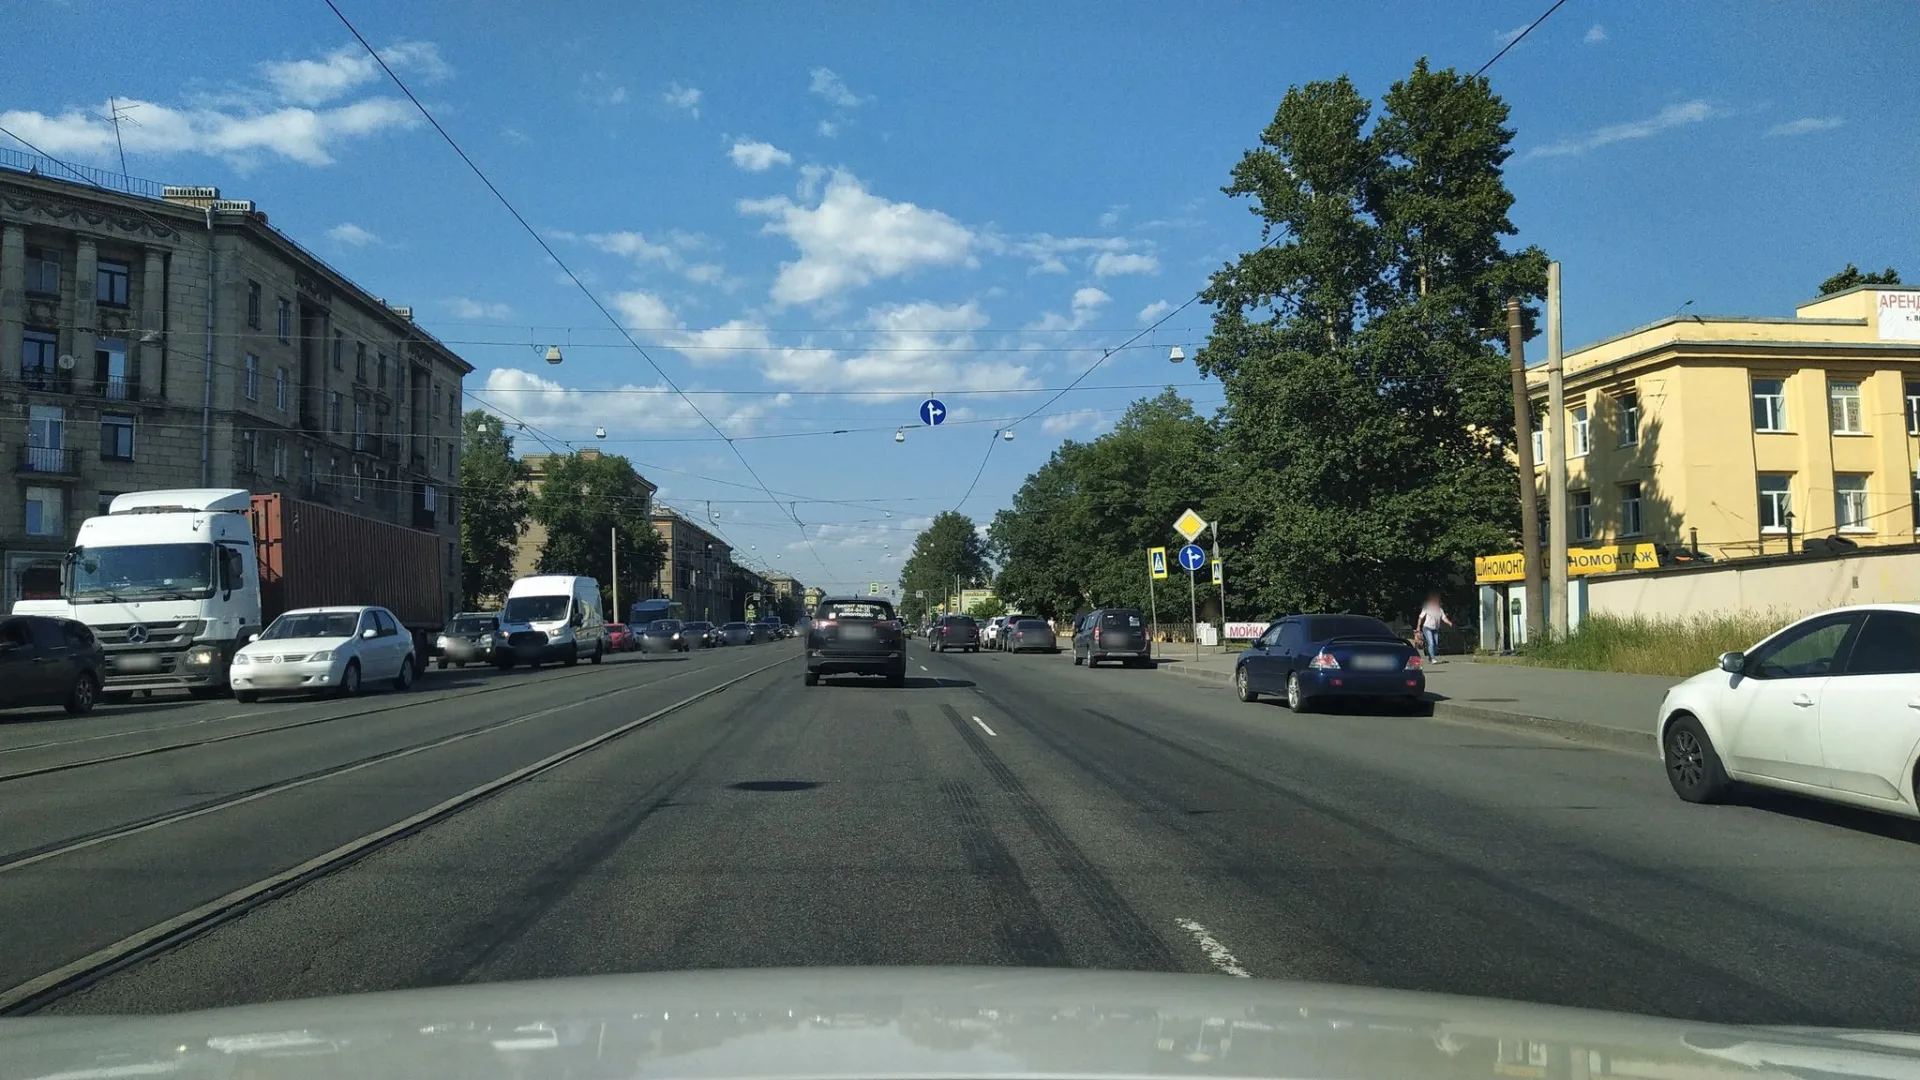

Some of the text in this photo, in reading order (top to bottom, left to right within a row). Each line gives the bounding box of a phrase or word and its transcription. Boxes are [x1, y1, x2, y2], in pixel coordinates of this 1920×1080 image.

[1476, 559, 1525, 576] ШИНОМОНТ
[1544, 551, 1653, 569] НОМОНТАЖ
[1230, 623, 1265, 637] МОЙКА
